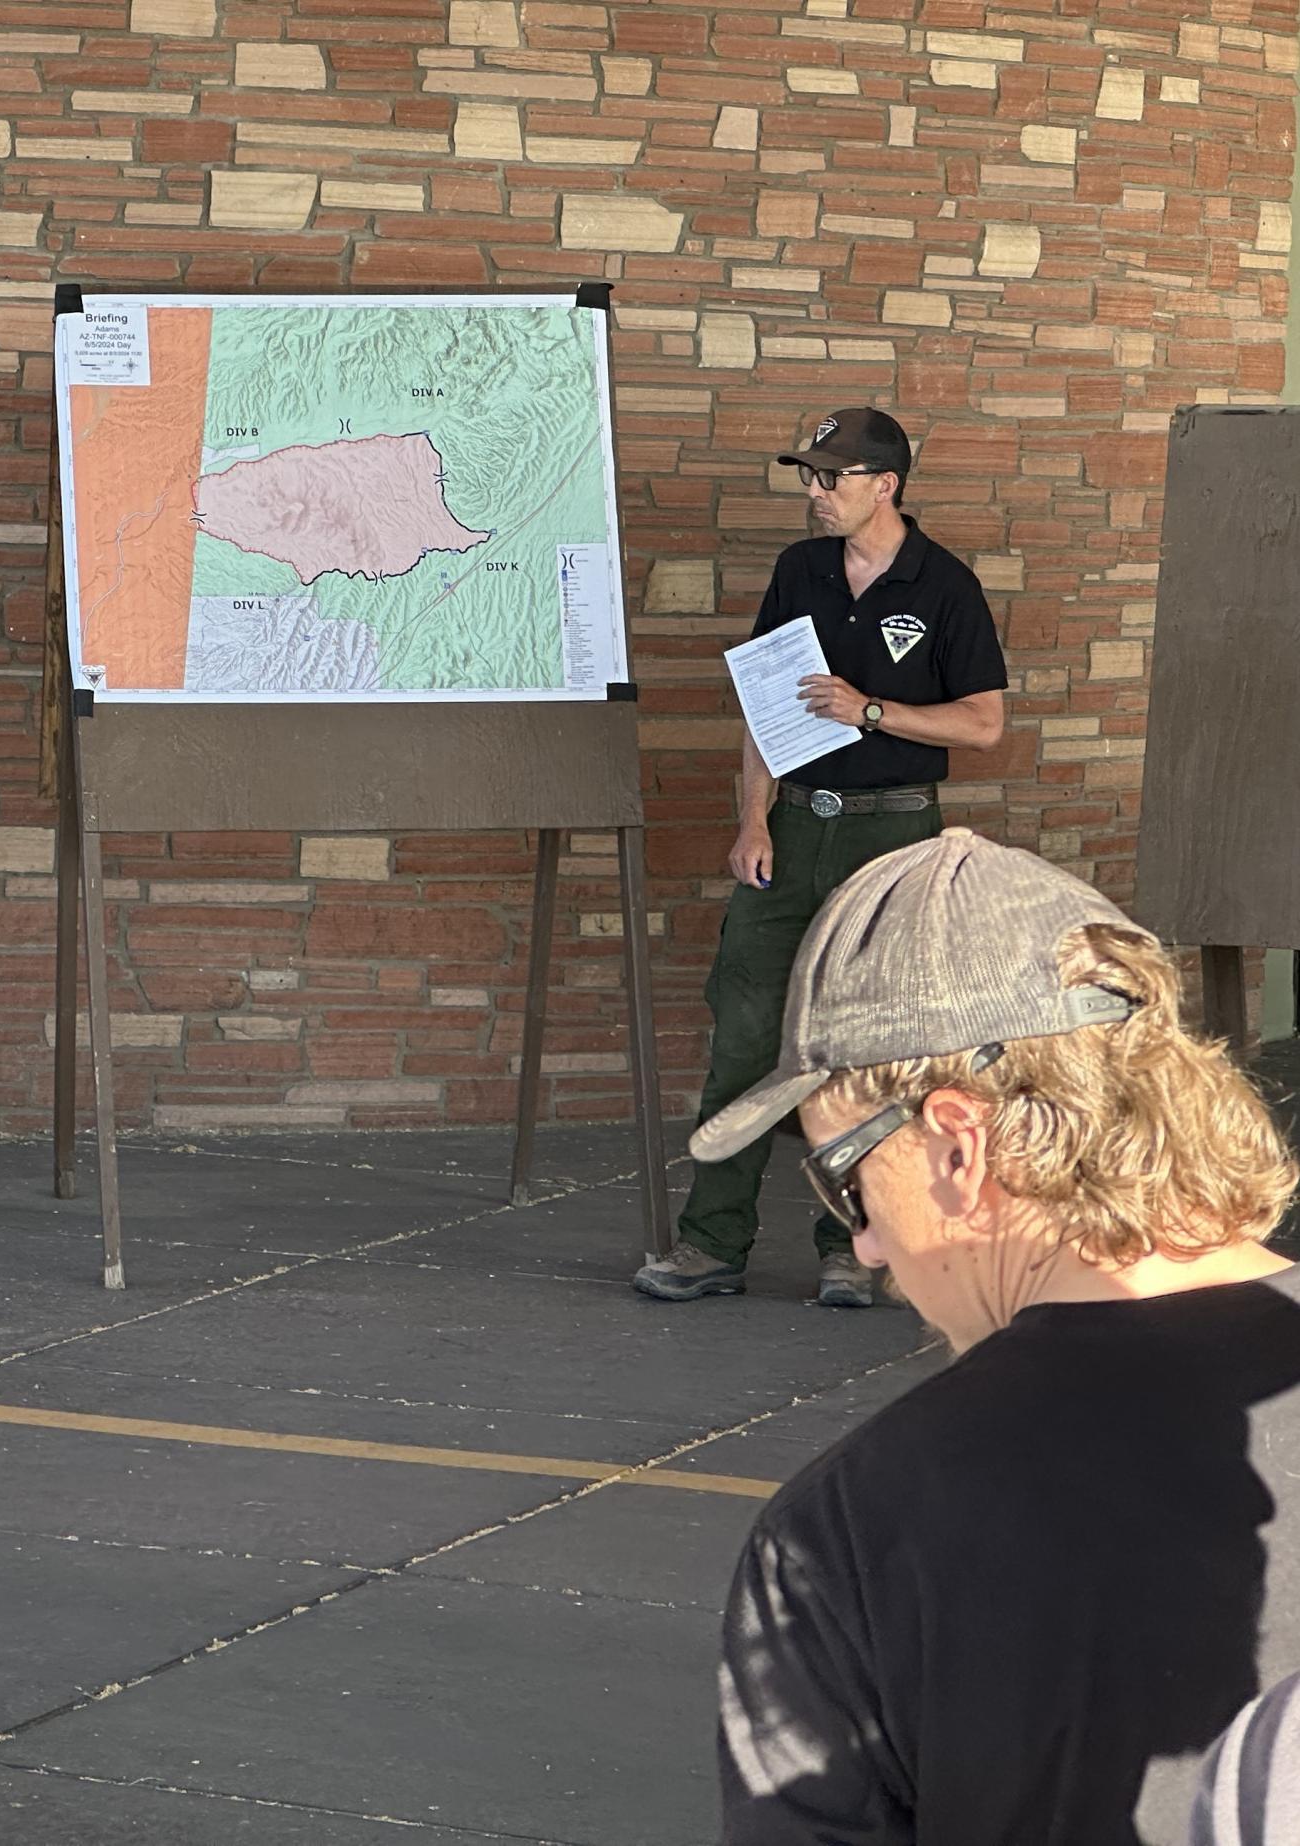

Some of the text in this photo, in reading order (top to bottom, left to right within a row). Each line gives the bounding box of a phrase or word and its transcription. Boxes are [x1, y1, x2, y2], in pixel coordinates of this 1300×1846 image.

[85, 313, 128, 325] Briefing
[117, 341, 131, 349] Day
[412, 388, 444, 397] DIV A
[226, 427, 259, 437] DIV B
[486, 562, 519, 571] DIV K
[233, 600, 265, 610] DIV L
